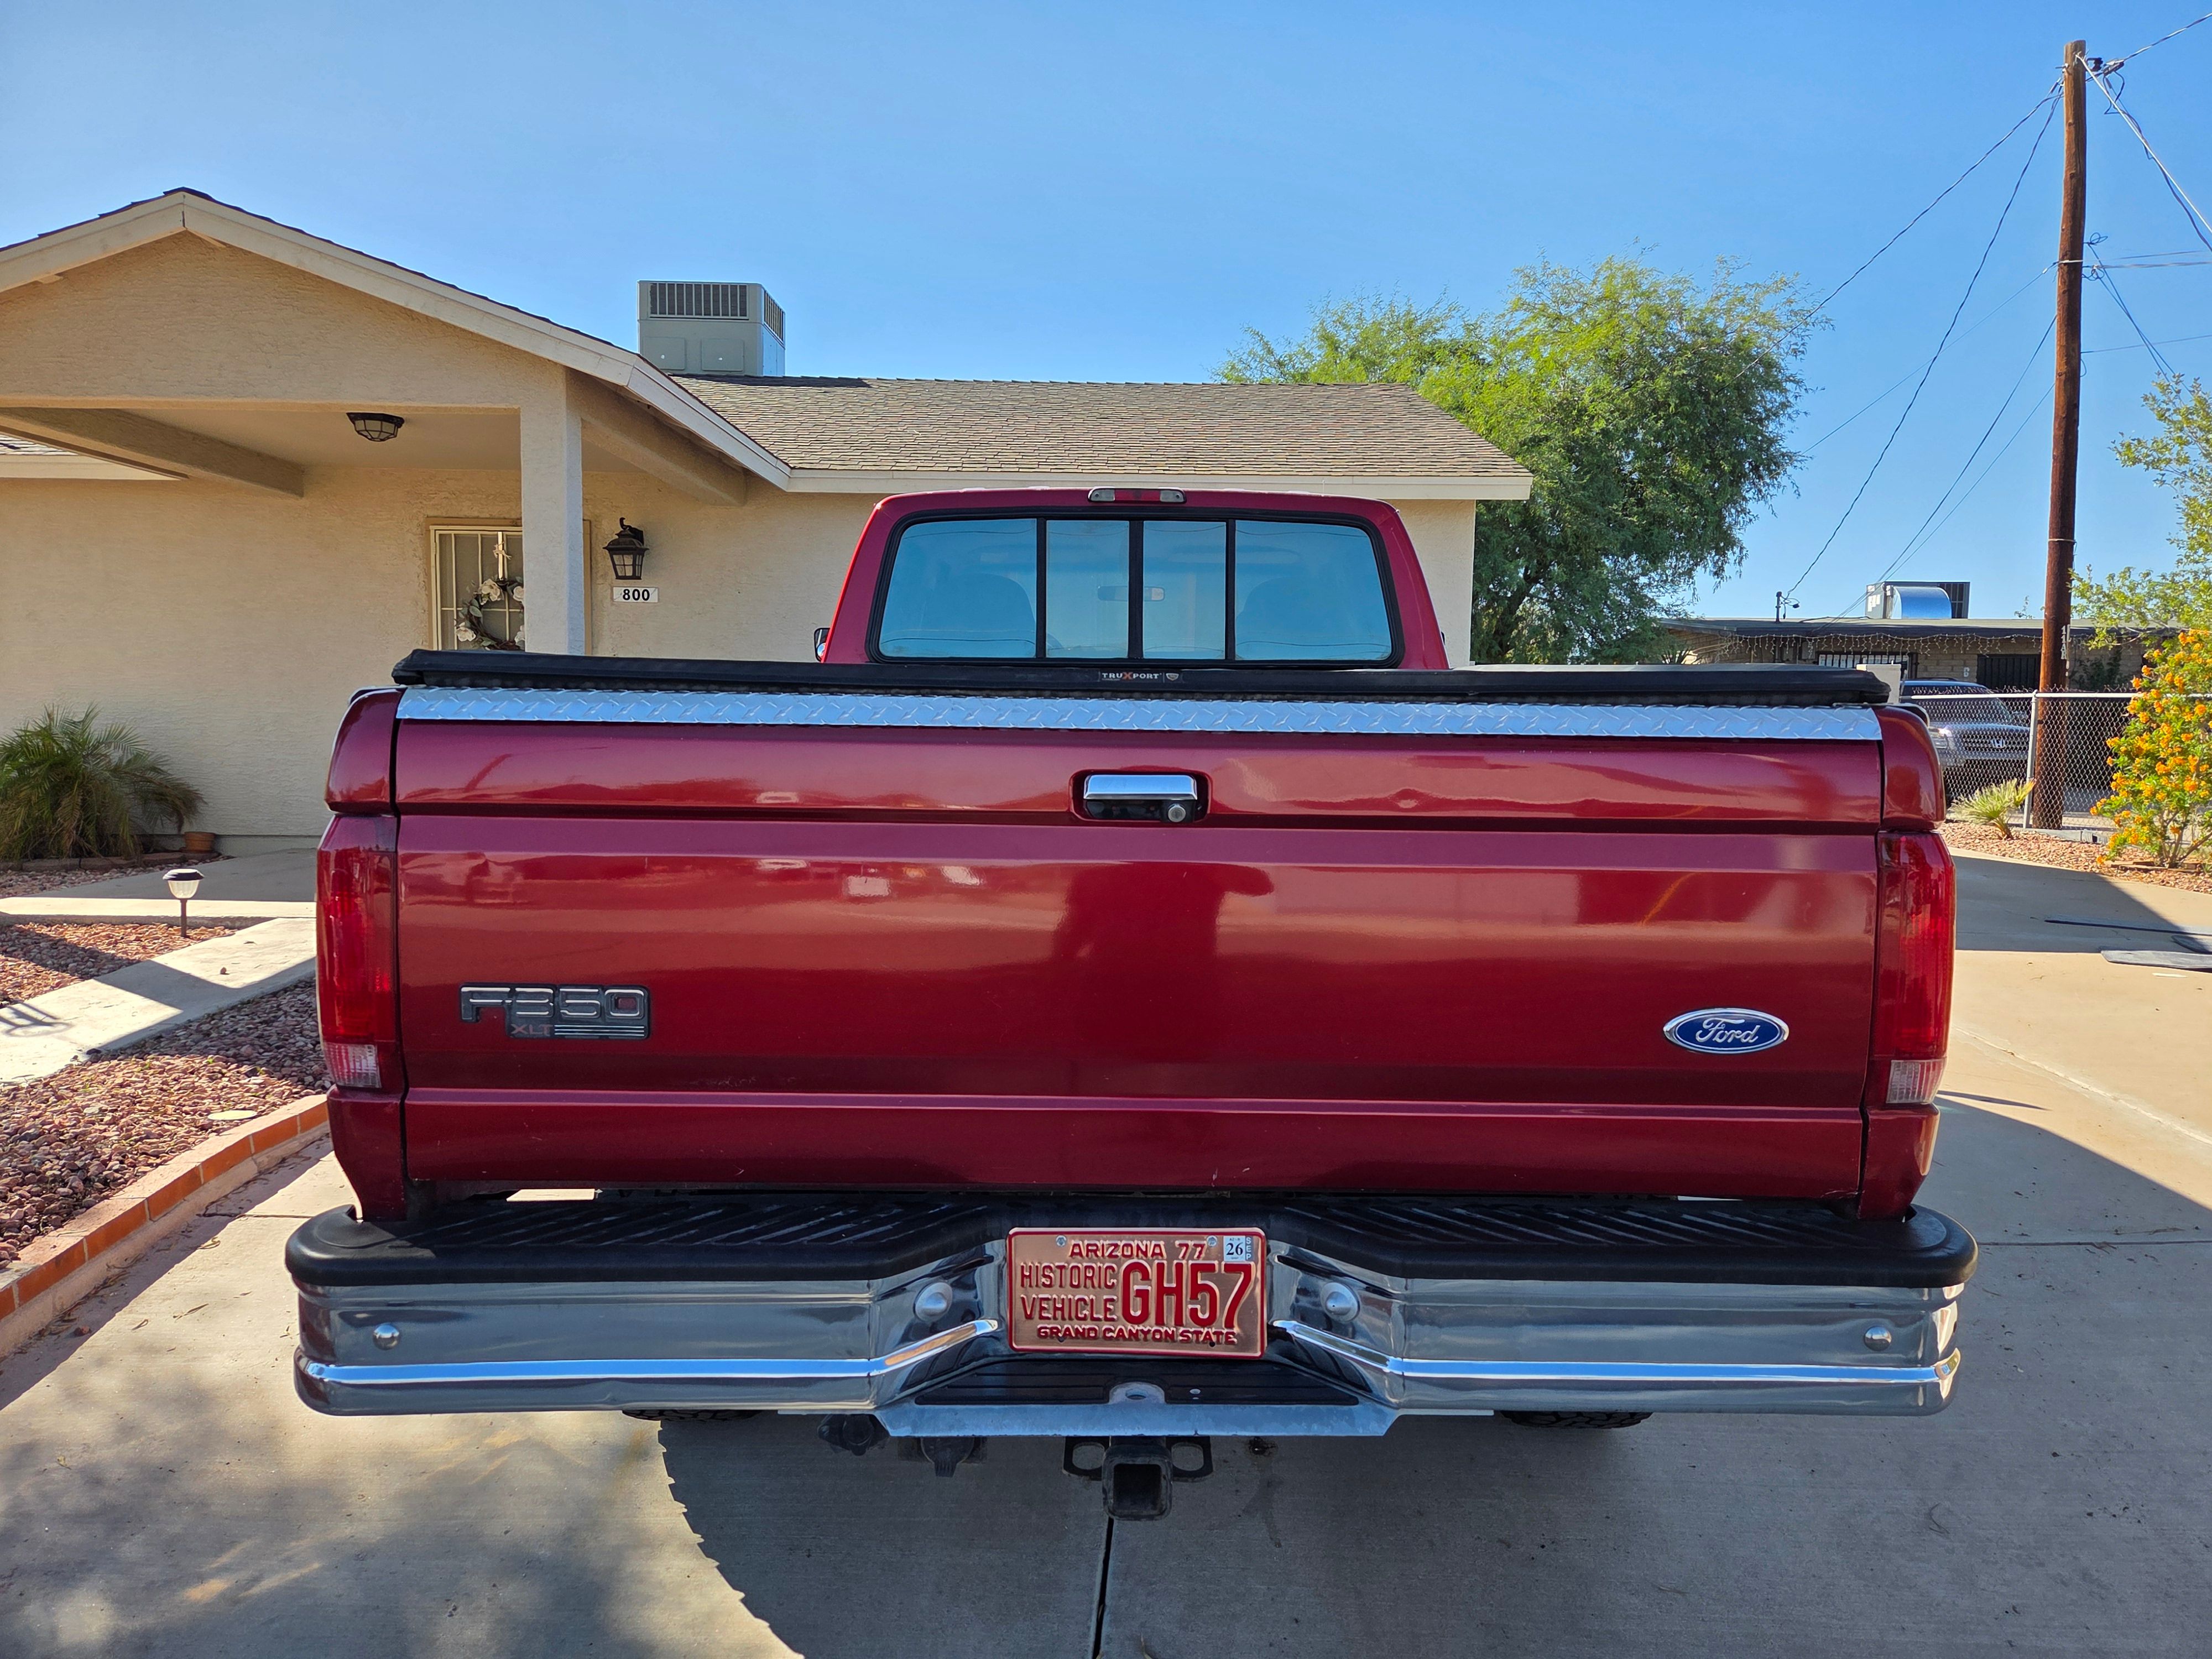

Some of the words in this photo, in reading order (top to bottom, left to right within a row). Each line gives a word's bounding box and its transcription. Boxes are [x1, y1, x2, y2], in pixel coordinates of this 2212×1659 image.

[623, 588, 650, 601] 800
[510, 1024, 552, 1035] XLT
[1695, 1017, 1761, 1044] Ford
[1069, 1240, 1166, 1259] ARIZONA
[1175, 1240, 1207, 1260] 77
[1226, 1242, 1243, 1256] 26
[1020, 1262, 1117, 1290] HISTORIC
[1121, 1259, 1255, 1329] GH57
[1020, 1294, 1118, 1322] VEHICLE
[1037, 1324, 1098, 1340] GRAND
[1103, 1324, 1176, 1344] CANYON
[1179, 1327, 1238, 1345] STATE
